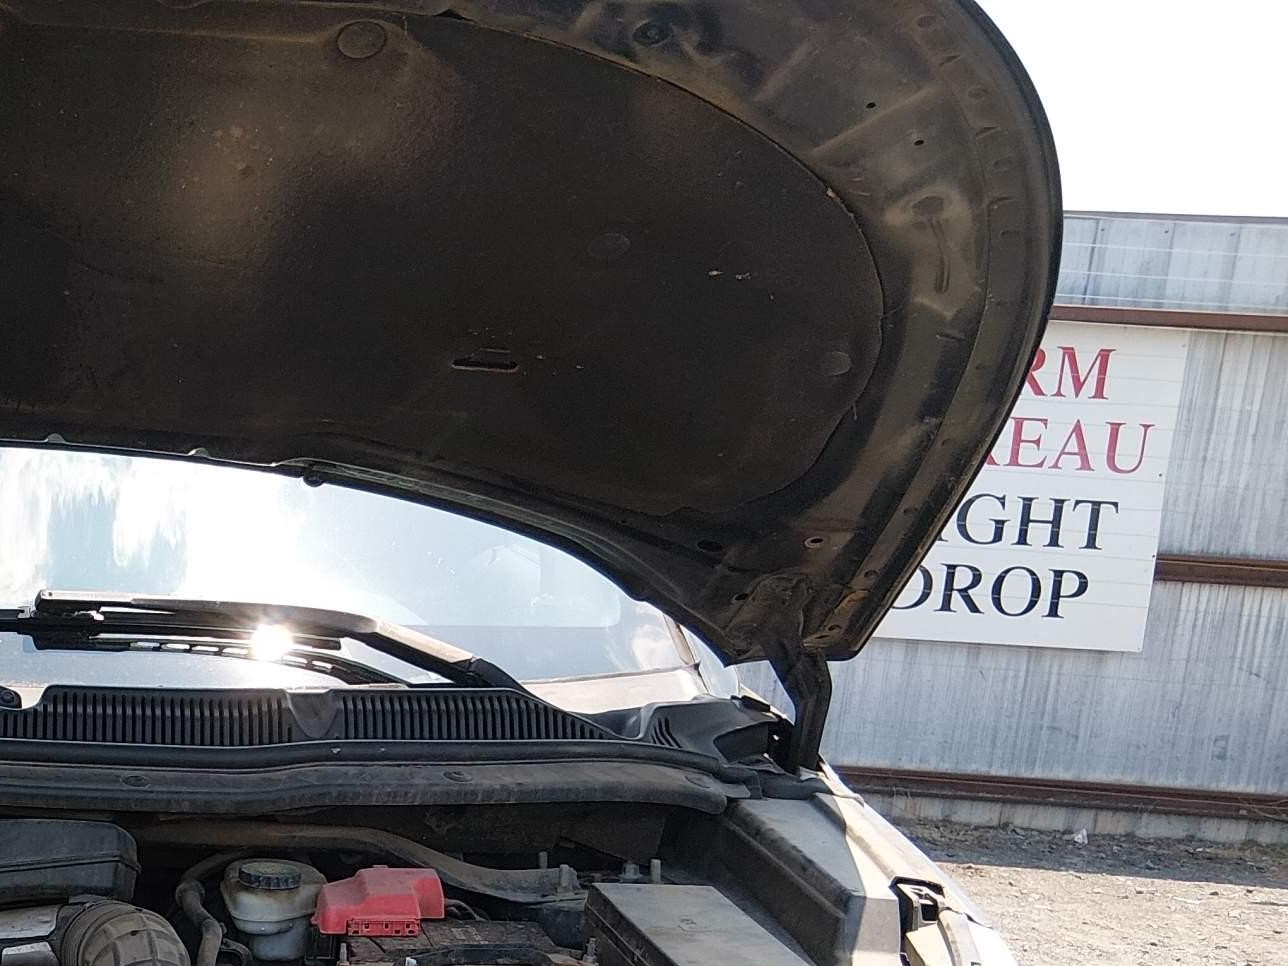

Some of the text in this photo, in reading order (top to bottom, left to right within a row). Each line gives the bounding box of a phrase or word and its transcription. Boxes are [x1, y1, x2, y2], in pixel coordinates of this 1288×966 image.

[985, 416, 1155, 474] EAU
[936, 492, 1120, 551] GHT
[890, 562, 1089, 619] DROP
